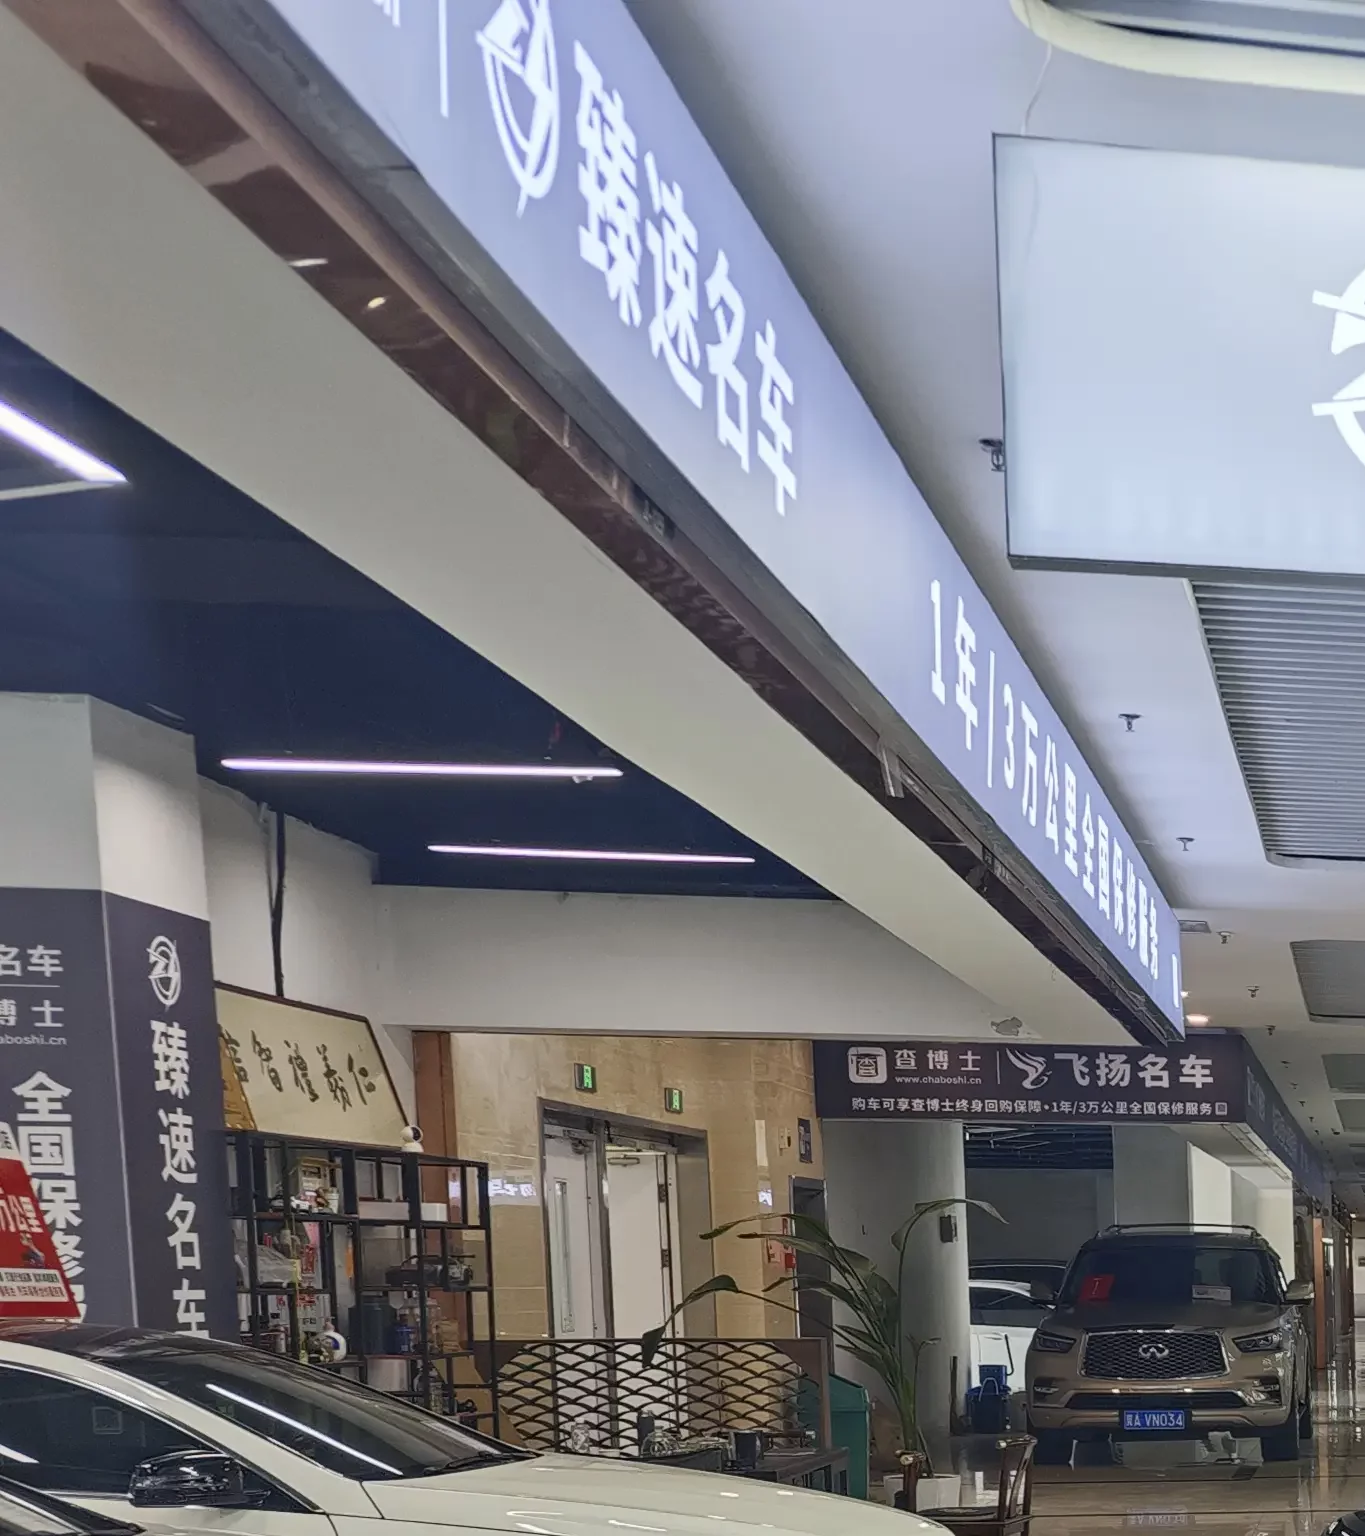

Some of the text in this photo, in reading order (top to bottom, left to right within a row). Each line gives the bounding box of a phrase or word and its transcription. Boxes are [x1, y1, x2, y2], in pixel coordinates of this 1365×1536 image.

[576, 38, 798, 517] 臻速名车
[893, 1048, 982, 1072] 查博士
[1054, 1052, 1214, 1089] 飞扬名车
[894, 1074, 983, 1086] www.chaboshi.cn
[149, 1018, 210, 1338] 臻速名车
